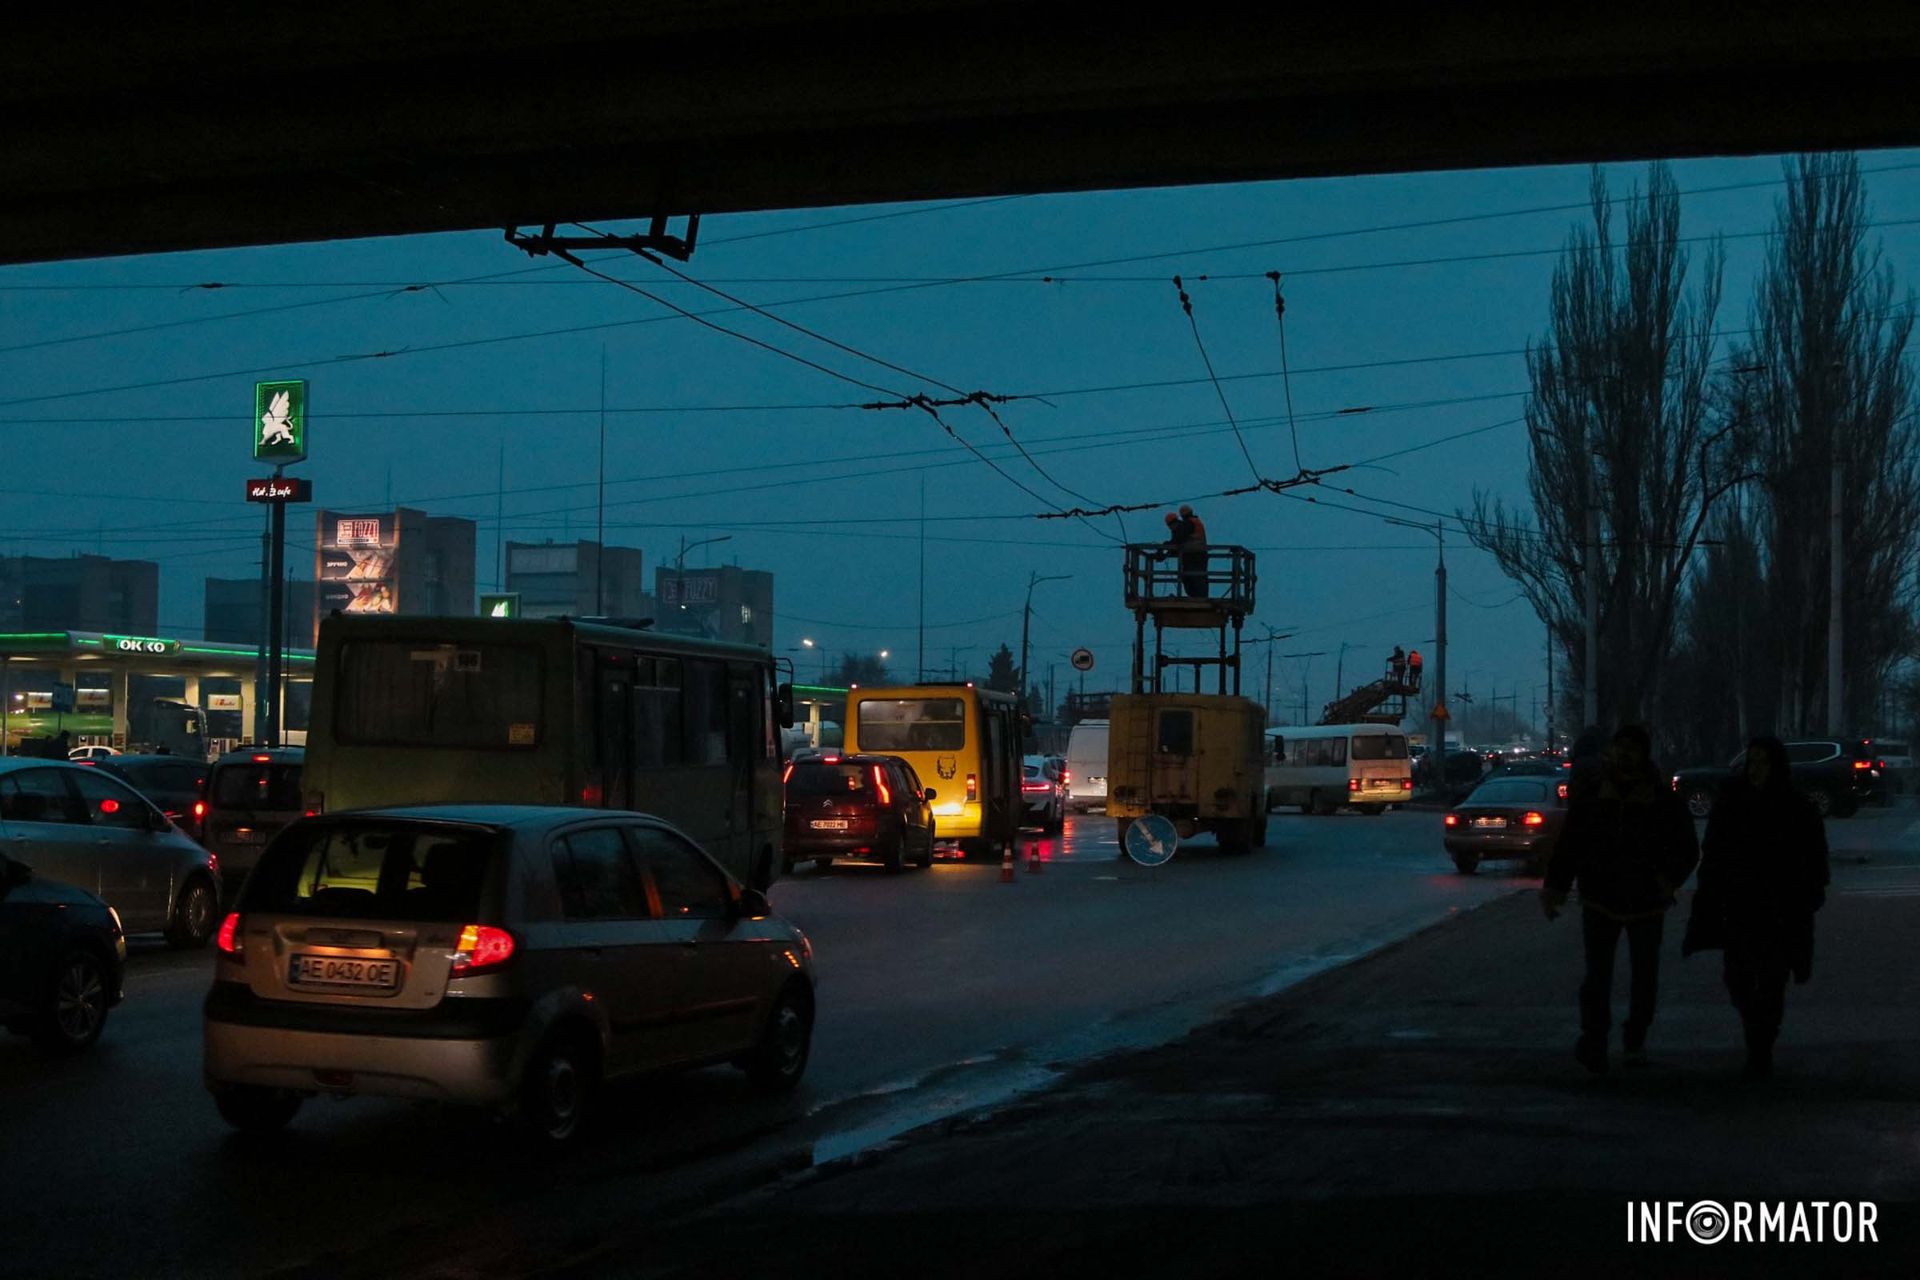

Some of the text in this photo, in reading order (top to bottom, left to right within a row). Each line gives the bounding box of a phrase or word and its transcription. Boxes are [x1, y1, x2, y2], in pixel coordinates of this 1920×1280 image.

[354, 521, 379, 538] FOZZY
[302, 960, 391, 983] AE 0432 OE
